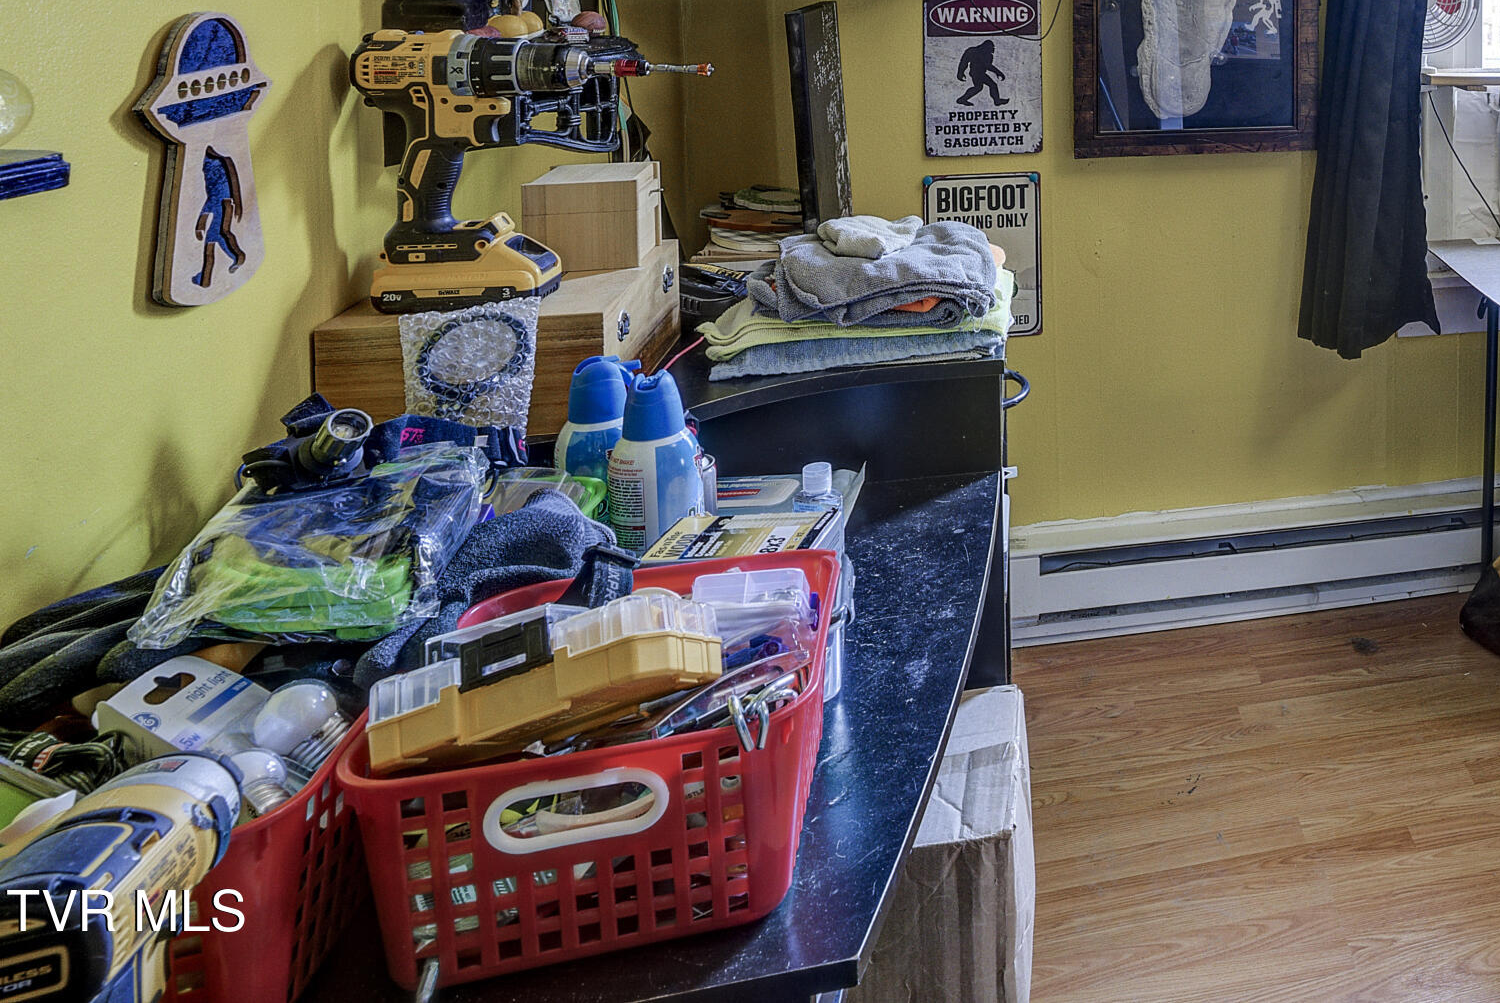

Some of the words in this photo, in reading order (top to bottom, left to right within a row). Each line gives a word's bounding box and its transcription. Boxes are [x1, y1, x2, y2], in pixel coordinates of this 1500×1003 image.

[936, 6, 1030, 24] WARNING
[450, 66, 463, 75] XR
[948, 109, 1019, 123] PROPERTY
[934, 122, 1010, 136] PORTECTED
[1013, 121, 1033, 133] BY
[943, 135, 1025, 149] SASQUATCH
[936, 183, 1029, 214] BIGFOOT
[996, 213, 1029, 228] ONLY
[663, 532, 699, 560] WOOD
[185, 683, 211, 703] night
[208, 669, 233, 689] light
